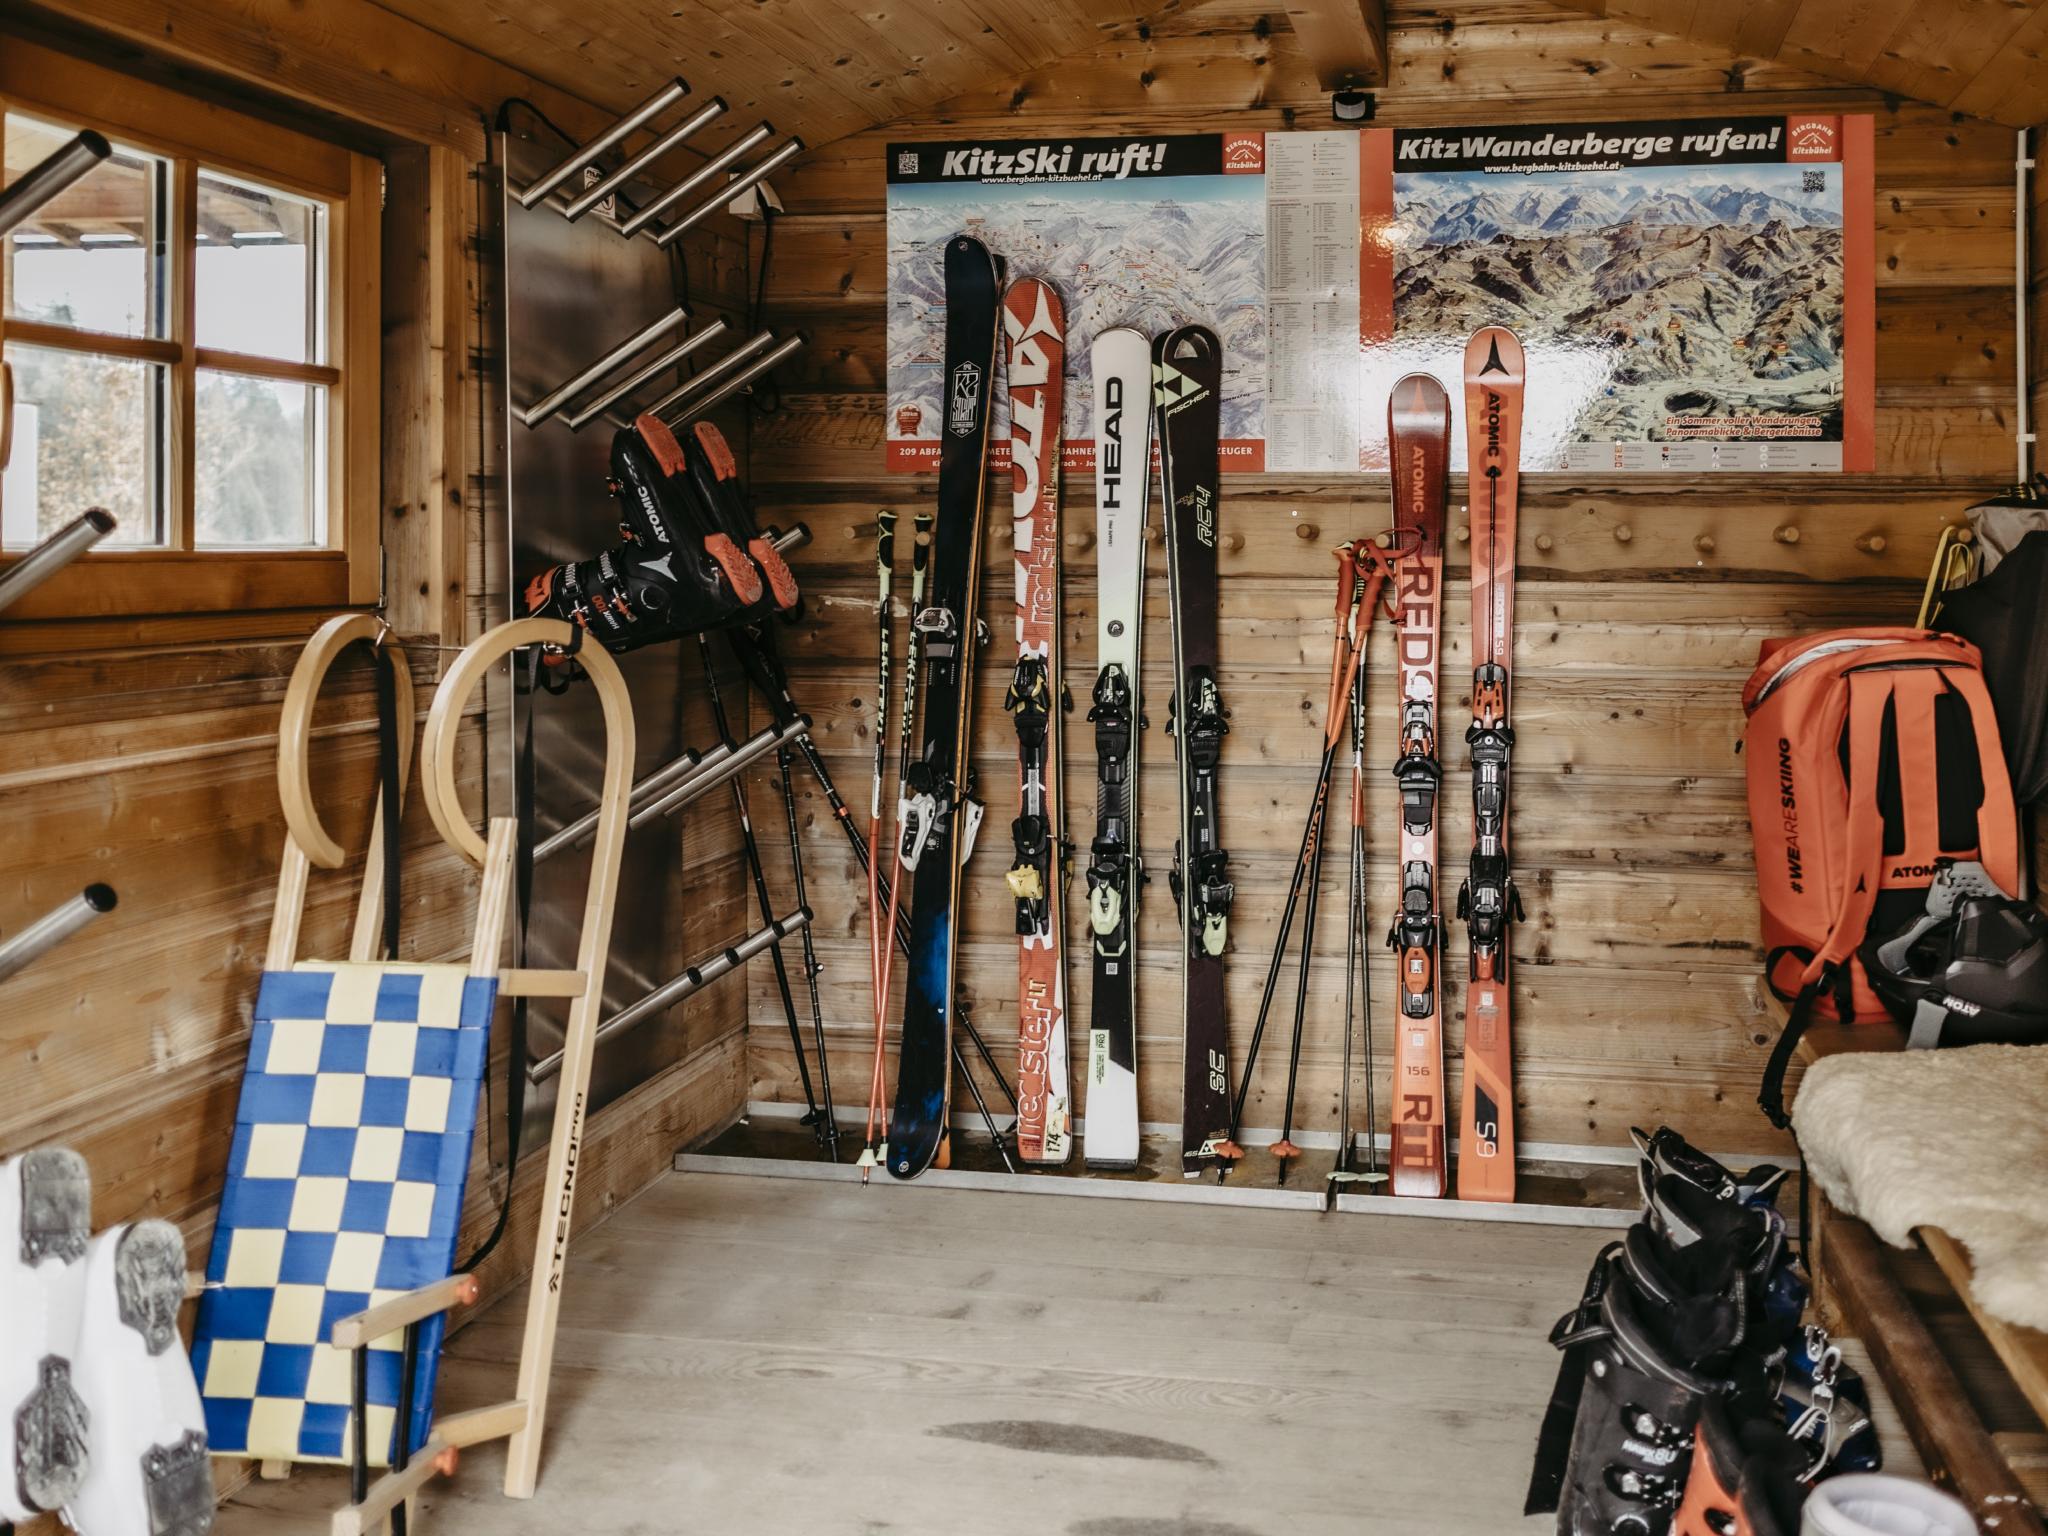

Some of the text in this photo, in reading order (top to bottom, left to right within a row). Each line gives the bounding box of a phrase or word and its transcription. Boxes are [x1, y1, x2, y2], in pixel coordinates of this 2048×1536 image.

[1791, 122, 1835, 138] BERGBAHN
[1225, 139, 1263, 153] BERGBAHN
[1398, 126, 1782, 160] KitzWanderberge rufen!
[1792, 146, 1832, 155] Kitzbühel
[941, 142, 1168, 180] KitzSki ruft!
[1225, 160, 1262, 169] Kitzbühel
[1484, 160, 1620, 175] www.bergbahn-kitzbuehel.at
[980, 172, 1104, 185] www.bergbahn-kitzbuehel.at
[1167, 389, 1210, 418] FISCHER
[1487, 391, 1500, 457] ATOMIC
[1666, 416, 1821, 427] Ein Sommer voller Wanderungen,
[1103, 376, 1123, 508] HEAD
[1666, 427, 1822, 438] Panoramablicke & Bergerlebnisse
[899, 447, 917, 456] 209
[919, 447, 942, 456] ABFA
[1217, 447, 1252, 456] ZEUGER
[1412, 446, 1425, 513] ATOMIC
[637, 485, 670, 543] ATOMIC
[1196, 484, 1213, 547] RC4
[1891, 865, 1938, 879] ATOM
[1029, 977, 1047, 997] LT
[1406, 1066, 1430, 1076] 156
[1402, 1094, 1433, 1167] RTi
[1475, 1120, 1497, 1158] S9
[1046, 1132, 1062, 1154] 174
